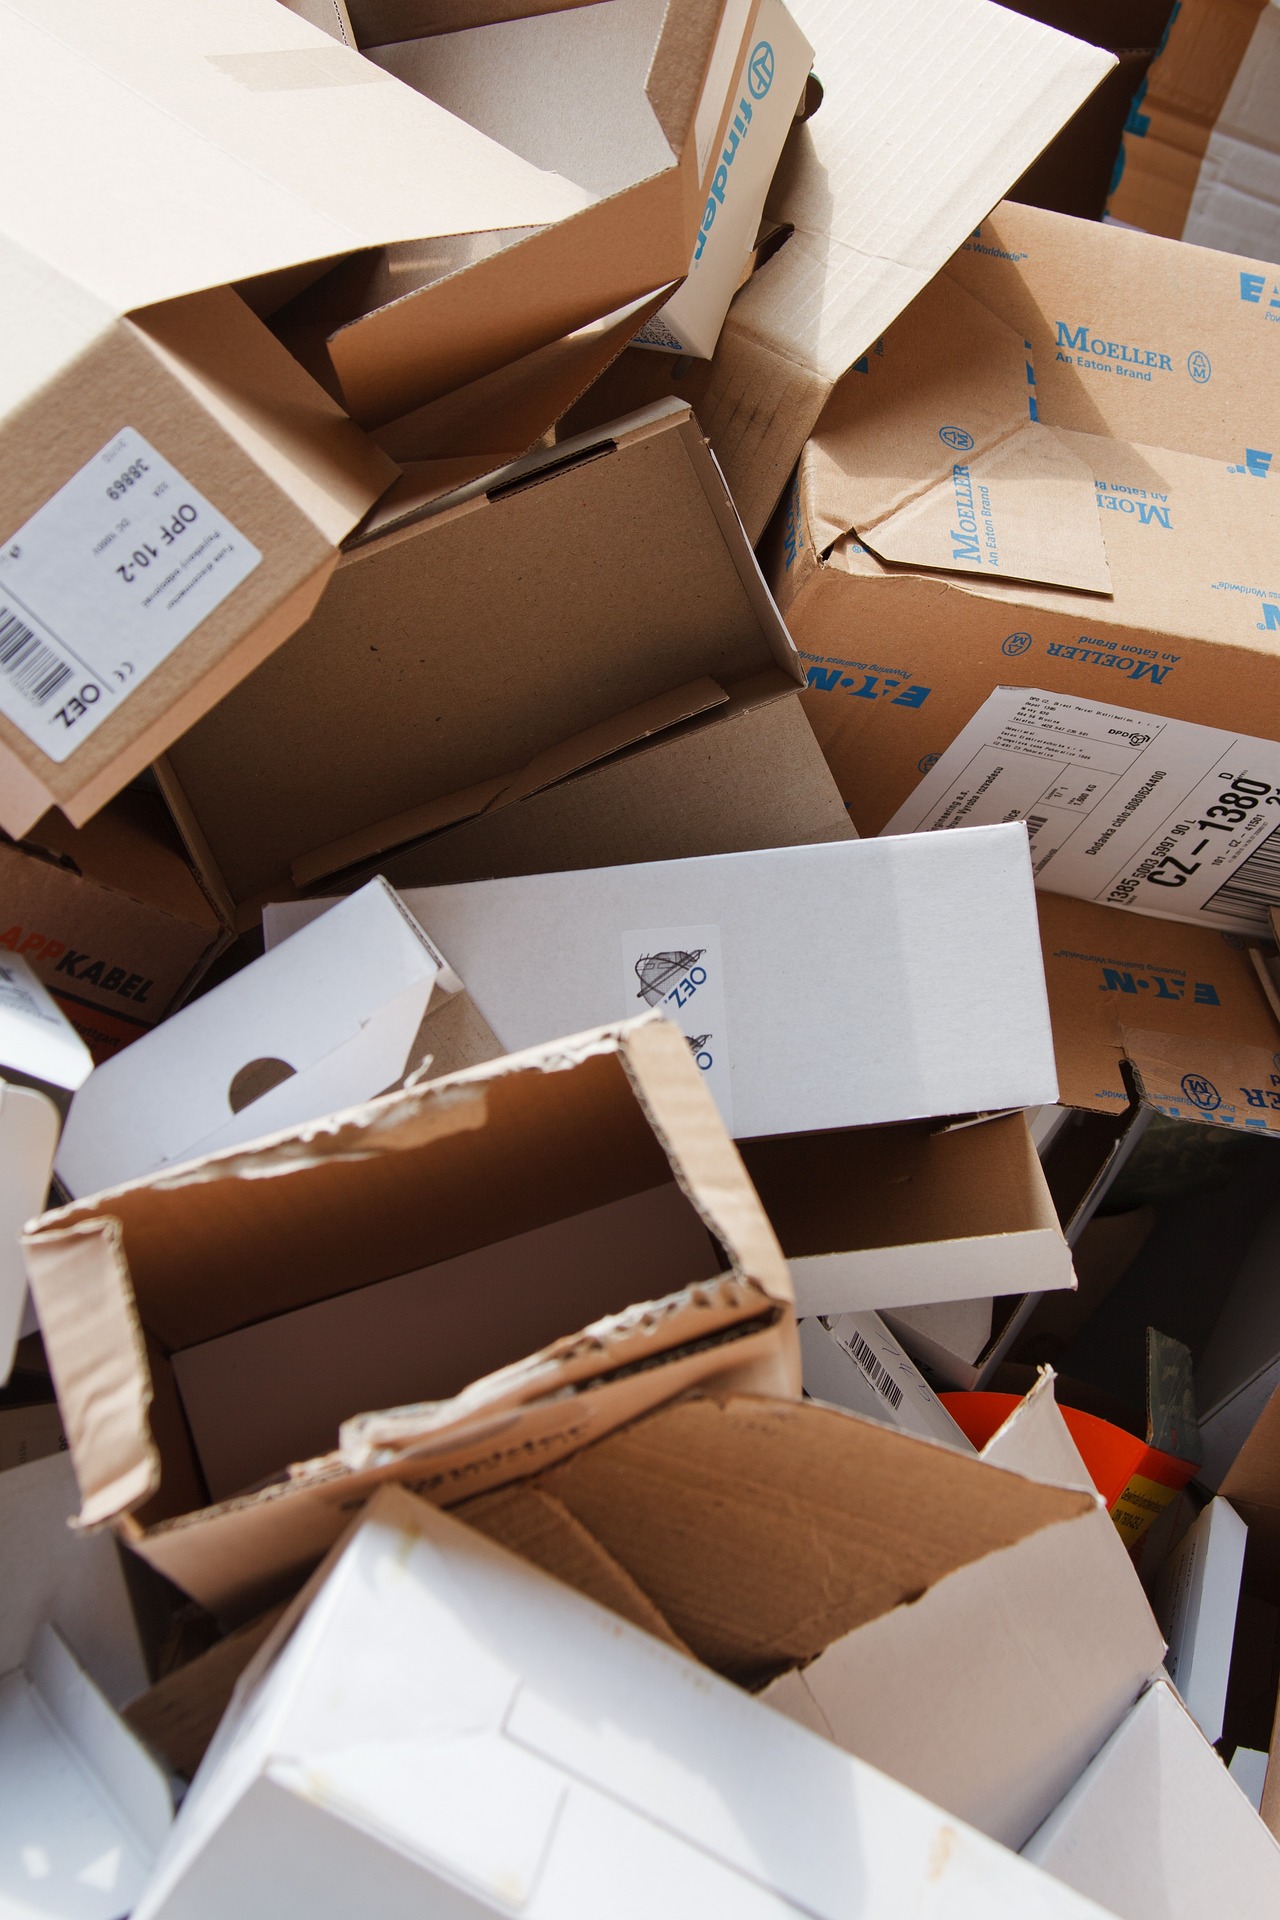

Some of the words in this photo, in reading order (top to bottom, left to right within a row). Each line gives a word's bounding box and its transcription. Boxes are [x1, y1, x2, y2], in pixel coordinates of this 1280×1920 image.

[694, 97, 753, 261] finder
[1055, 352, 1073, 364] An
[1077, 353, 1112, 373] Eaton
[1116, 364, 1152, 381] Brand
[105, 458, 149, 501] 38869
[1111, 483, 1147, 499] Eaton
[977, 485, 992, 517] Brand
[1150, 492, 1168, 502] An
[159, 503, 198, 546] OPF
[984, 519, 997, 549] Eaton
[115, 542, 160, 585] 10-2
[988, 551, 999, 567] An
[1077, 635, 1119, 650] Brand
[1120, 644, 1159, 659] Eaton
[826, 657, 868, 671] Business
[868, 664, 913, 680] Powering
[1161, 653, 1182, 664] An
[53, 683, 101, 729] OEZ
[1107, 728, 1129, 738] DPD
[1218, 772, 1234, 780] D
[926, 800, 962, 832] ngineering
[957, 793, 980, 815] Vyroba
[1085, 828, 1117, 856] Dodavka
[1106, 878, 1141, 904] 1385
[1151, 836, 1179, 858] 5997
[1170, 824, 1191, 836] 90
[668, 966, 707, 1009] OEZ
